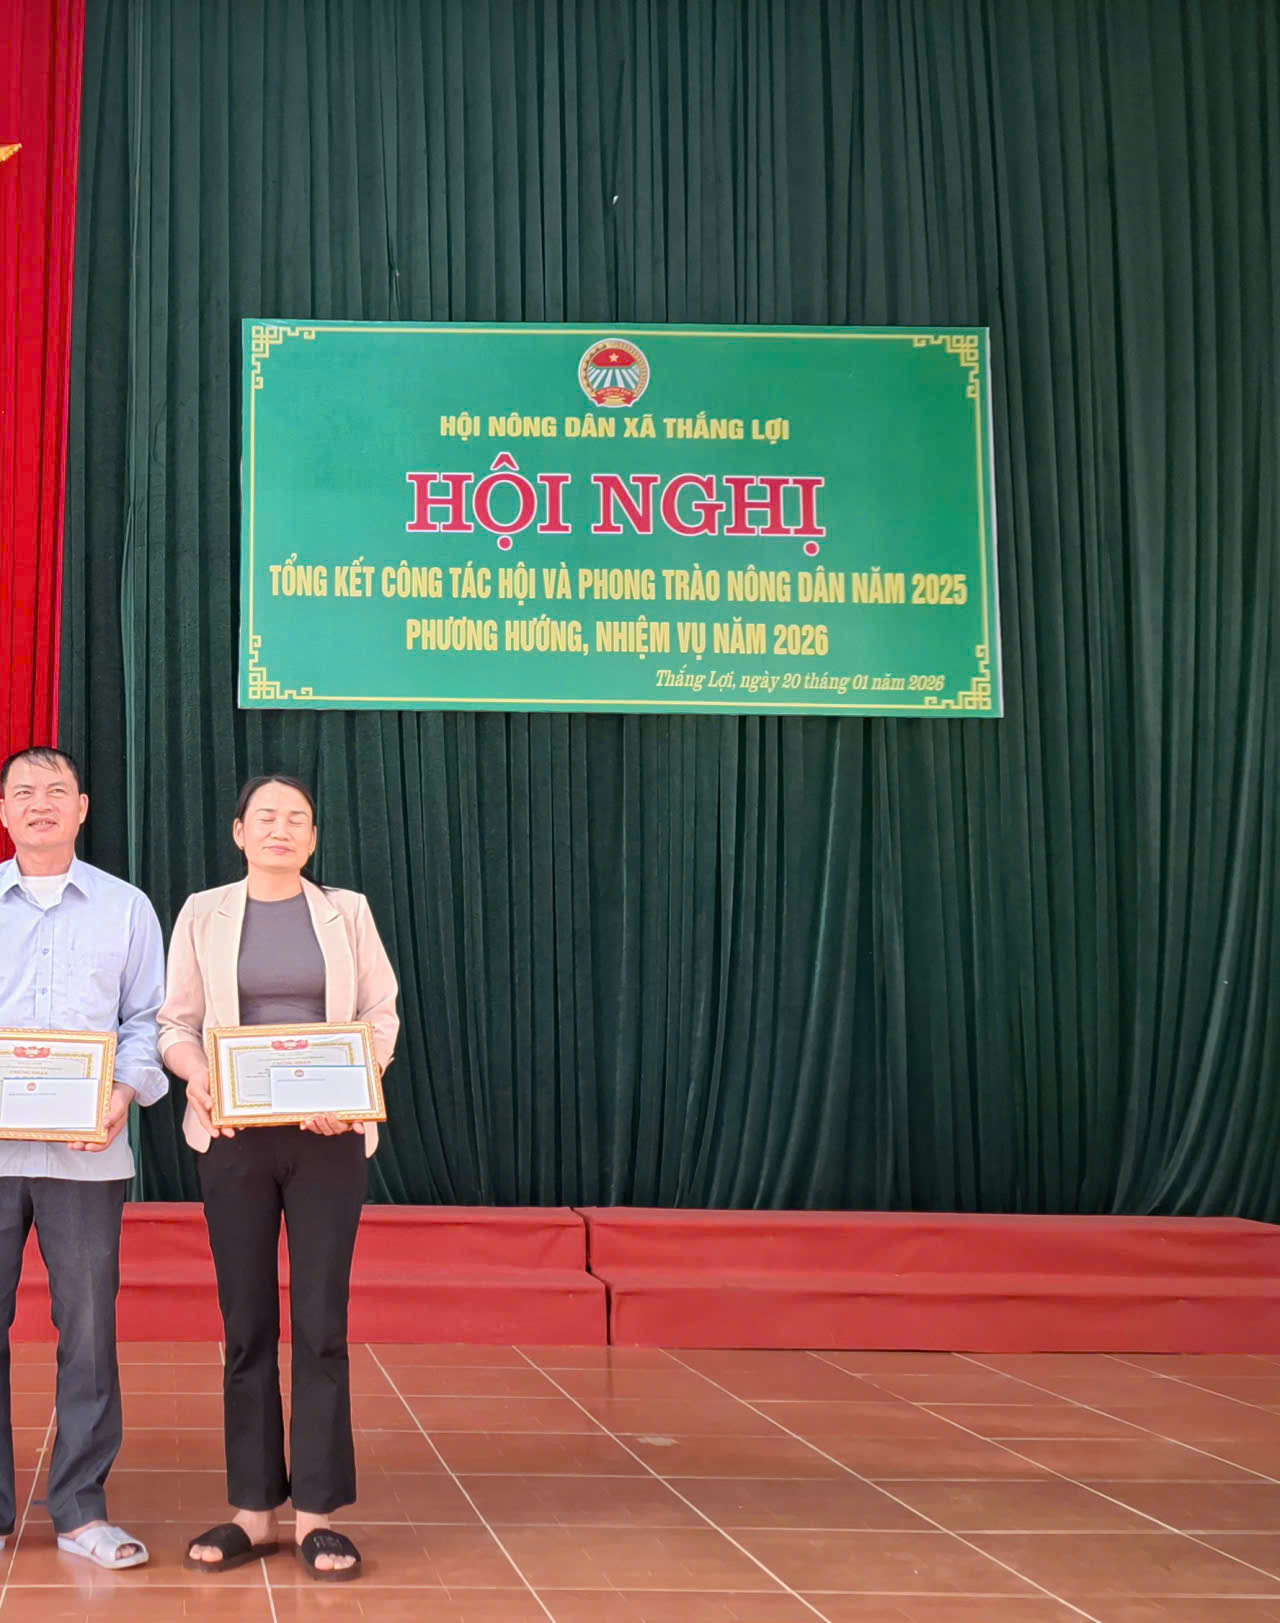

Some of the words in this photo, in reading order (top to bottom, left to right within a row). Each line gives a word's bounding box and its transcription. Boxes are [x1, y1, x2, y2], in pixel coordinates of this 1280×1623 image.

[440, 411, 481, 441] HỘI
[488, 412, 557, 438] NÔNG
[565, 413, 616, 438] DÂN
[623, 413, 657, 439] XÃ
[663, 411, 745, 440] THẮNG
[751, 417, 790, 445] LỢI
[406, 451, 572, 551] HỘI
[591, 473, 826, 557] NGHỊ
[269, 552, 328, 597] TỔNG
[334, 556, 375, 597] KẾT
[381, 560, 443, 598] CÔNG
[449, 560, 492, 599] TÁC
[498, 561, 536, 606] HỘI
[542, 561, 572, 600] VÀ
[578, 567, 656, 600] PHONG
[662, 562, 721, 602] TRÀO
[727, 564, 791, 602] NÔNG
[798, 565, 845, 603] DÂN
[852, 566, 905, 604] NĂM
[911, 573, 968, 605] 2025
[406, 616, 499, 651] PHƯƠNG
[505, 613, 589, 656] HƯỚNG,
[596, 614, 670, 660] NHIỆM
[677, 621, 706, 661] VỤ
[713, 616, 766, 655] NĂM
[773, 624, 829, 656] 2026
[655, 664, 706, 692] Thắng
[707, 670, 736, 692] Lợi,
[739, 670, 780, 693] ngày
[781, 673, 801, 689] 20
[804, 672, 850, 695] tháng
[852, 674, 869, 690] 01
[871, 673, 905, 691] năm
[907, 675, 945, 692] 2026
